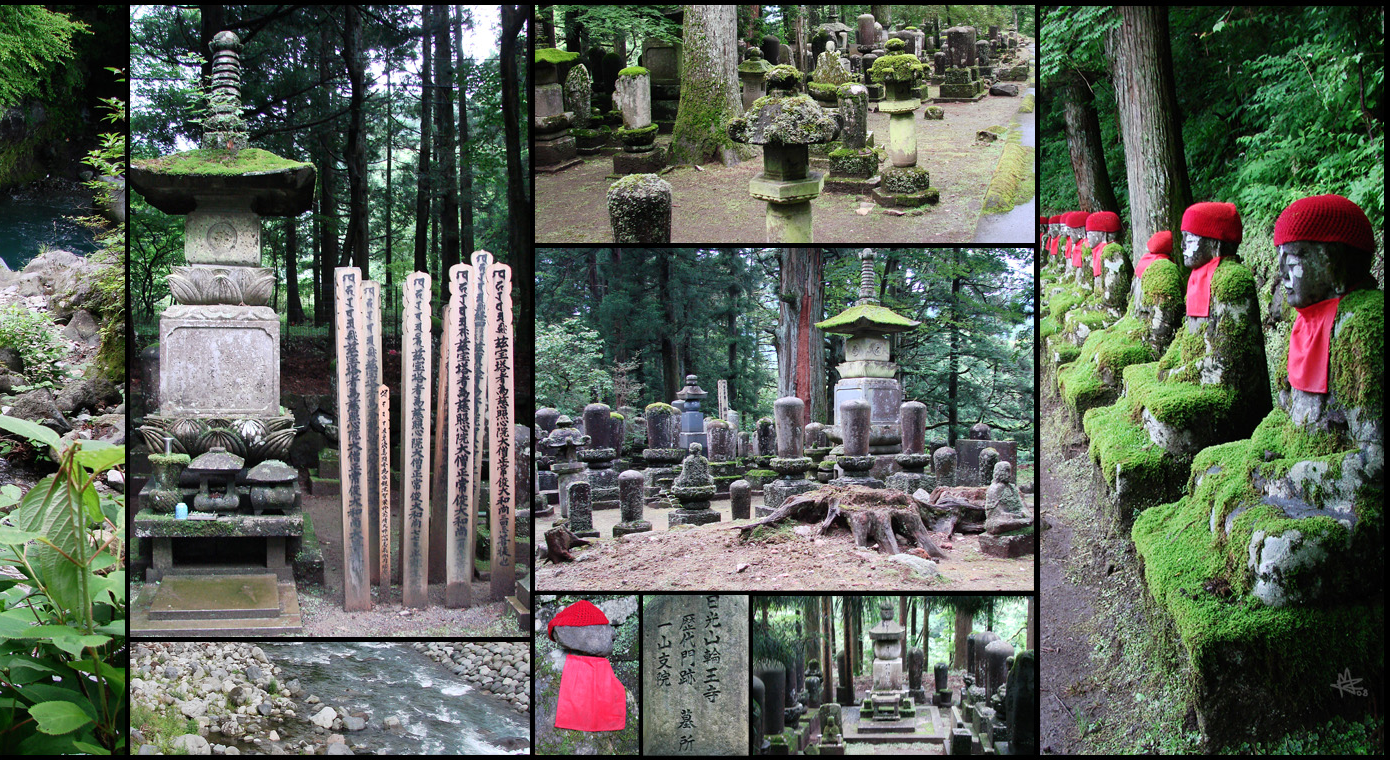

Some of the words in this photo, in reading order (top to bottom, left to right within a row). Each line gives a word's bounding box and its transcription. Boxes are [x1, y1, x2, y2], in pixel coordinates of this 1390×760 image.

[656, 621, 673, 687] 一山支院
[703, 595, 721, 703] 日光山輪王寺
[678, 709, 697, 752] 墓所
